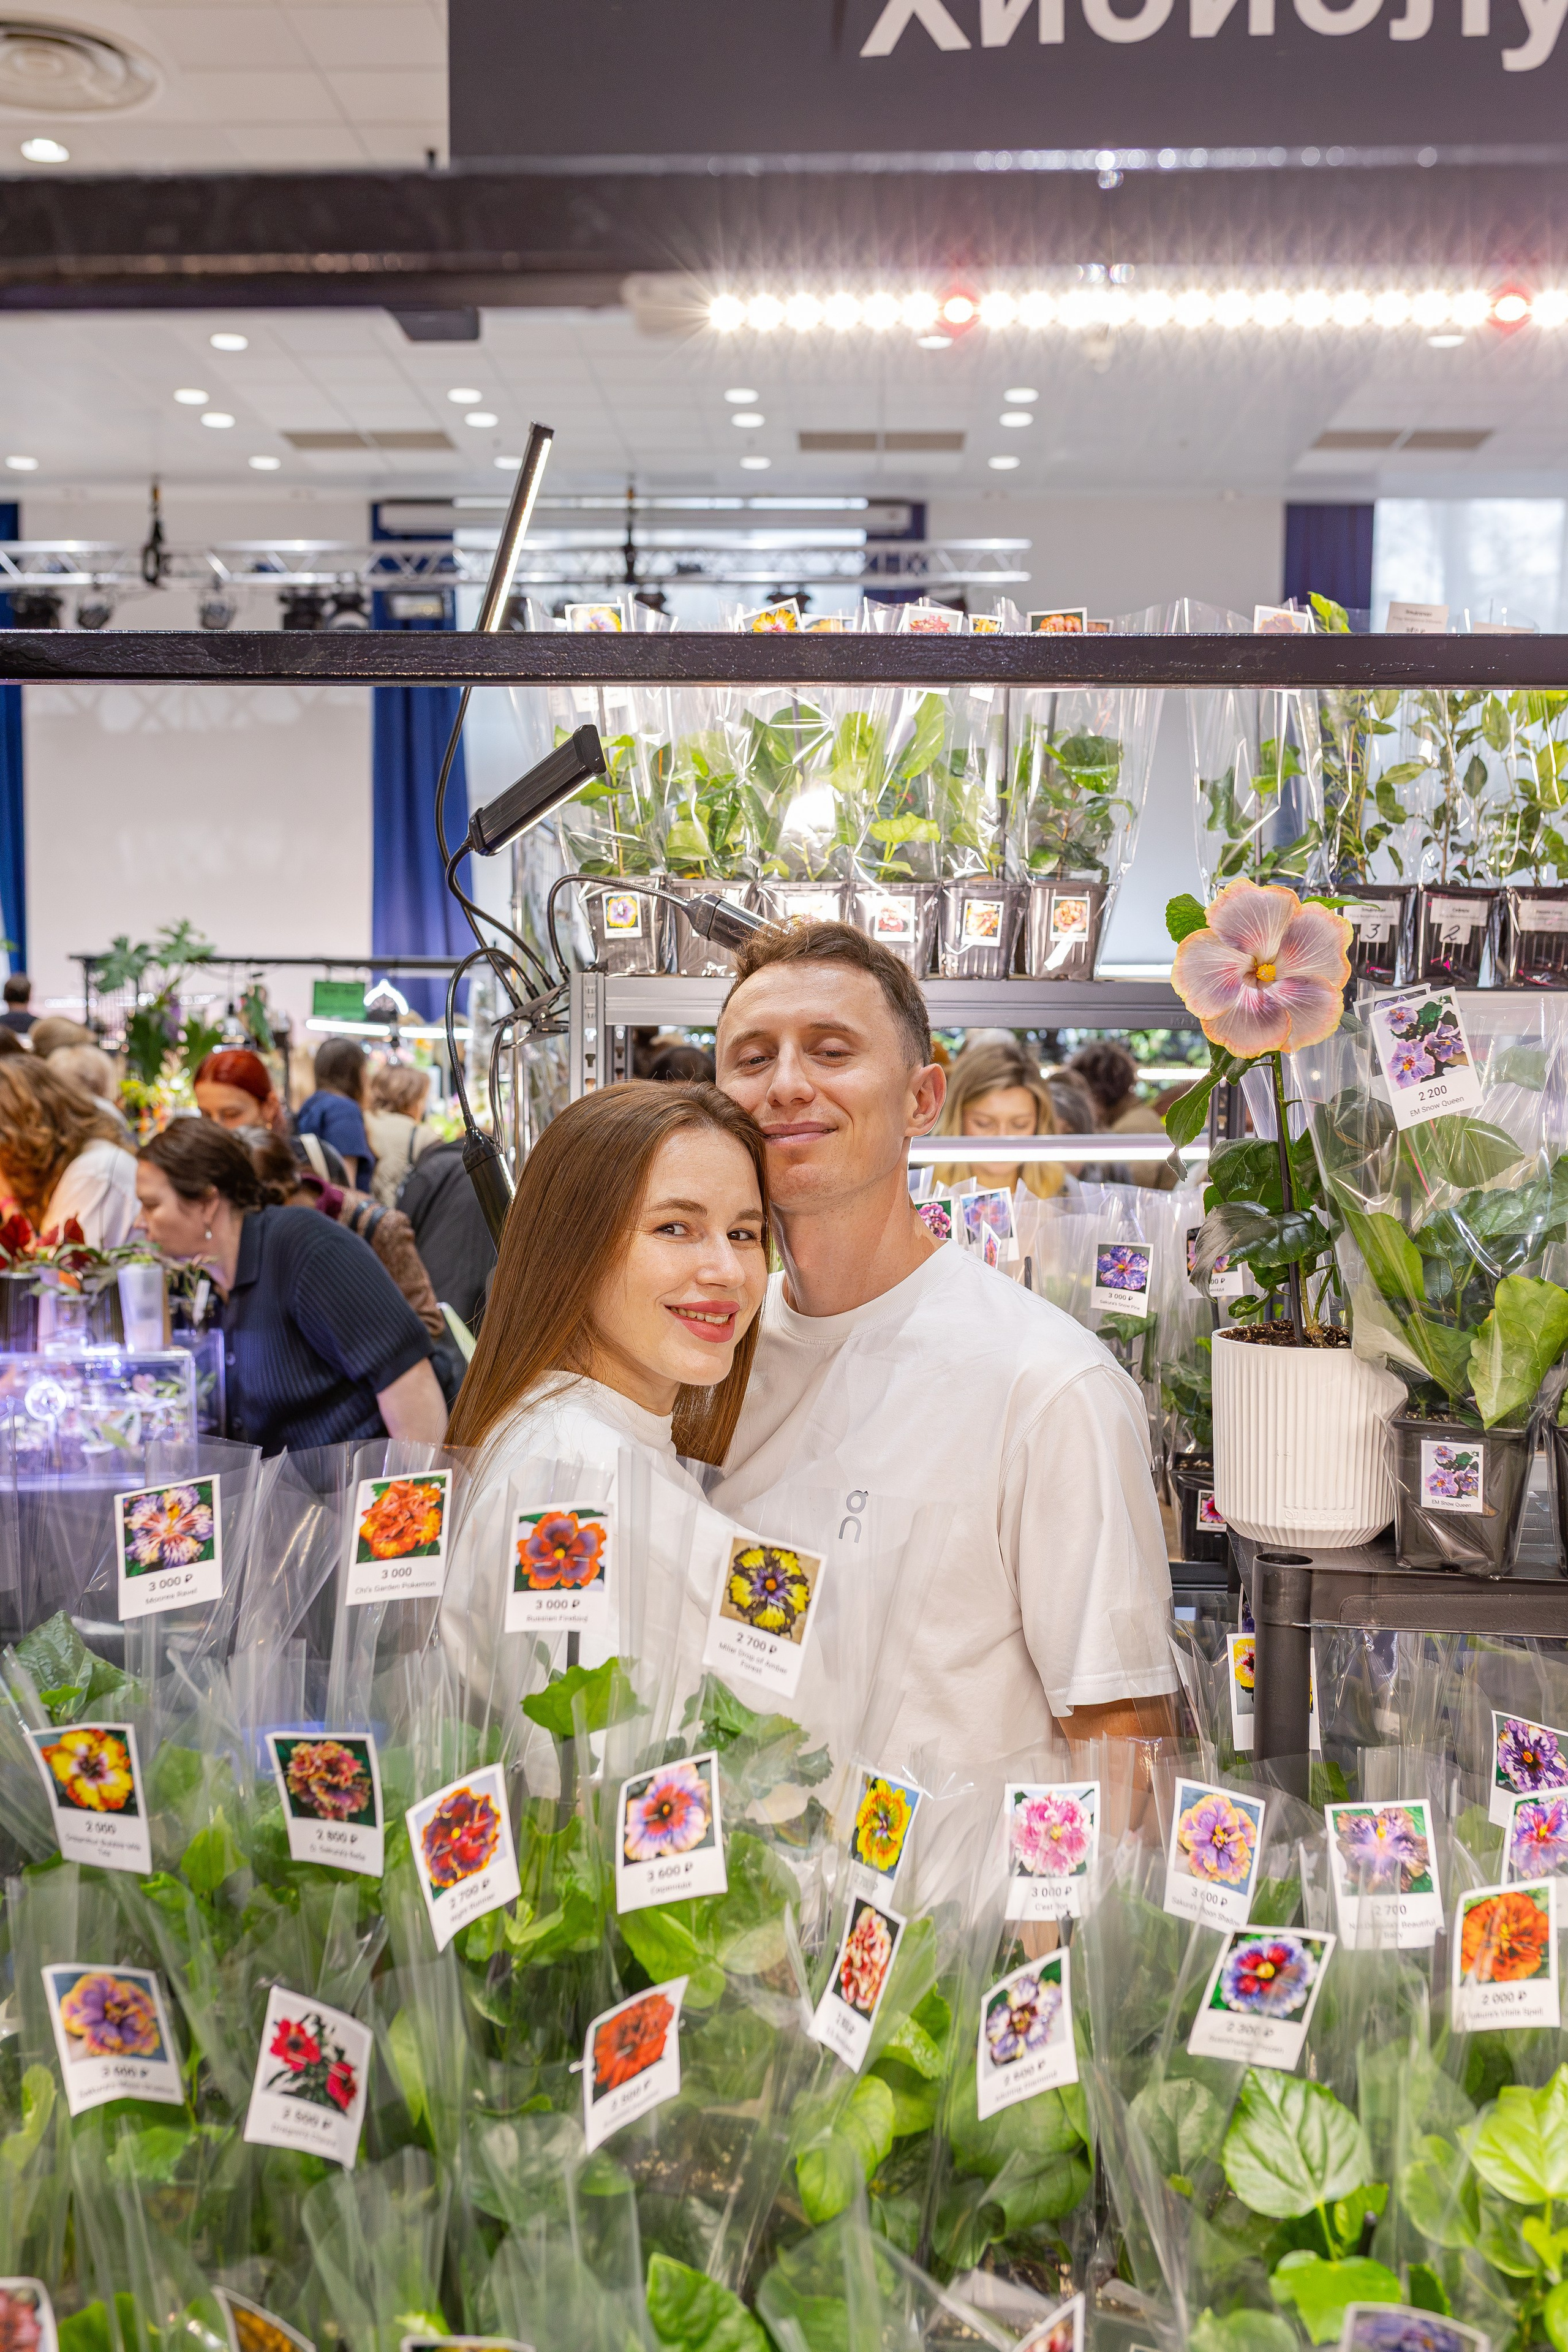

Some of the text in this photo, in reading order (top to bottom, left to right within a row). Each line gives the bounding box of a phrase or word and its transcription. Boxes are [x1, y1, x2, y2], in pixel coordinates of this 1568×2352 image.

[1366, 924, 1381, 939] 3
[1442, 925, 1461, 941] 2
[1419, 1085, 1447, 1101] 2 200
[1422, 1103, 1440, 1113] Snow
[1441, 1096, 1464, 1107] Queen
[382, 1567, 412, 1579] 3 000
[149, 1581, 156, 1591] 3
[159, 1577, 181, 1589] 000
[536, 1599, 543, 1610] 3
[546, 1599, 568, 1610] 000
[737, 1632, 744, 1643] 2
[747, 1635, 767, 1651] 700
[86, 1820, 92, 1833] 2
[316, 1829, 323, 1840] 2
[647, 1869, 654, 1882] 3
[658, 1866, 680, 1879] 600
[450, 1897, 456, 1909] 2
[459, 1885, 478, 1902] 700
[1031, 1887, 1038, 1897] 3
[1042, 1887, 1061, 1897] 000
[1191, 1887, 1197, 1897] 3
[1373, 1905, 1407, 1916] 2 700
[1401, 1918, 1436, 1929] Beautiful
[1482, 1994, 1489, 2005] 2
